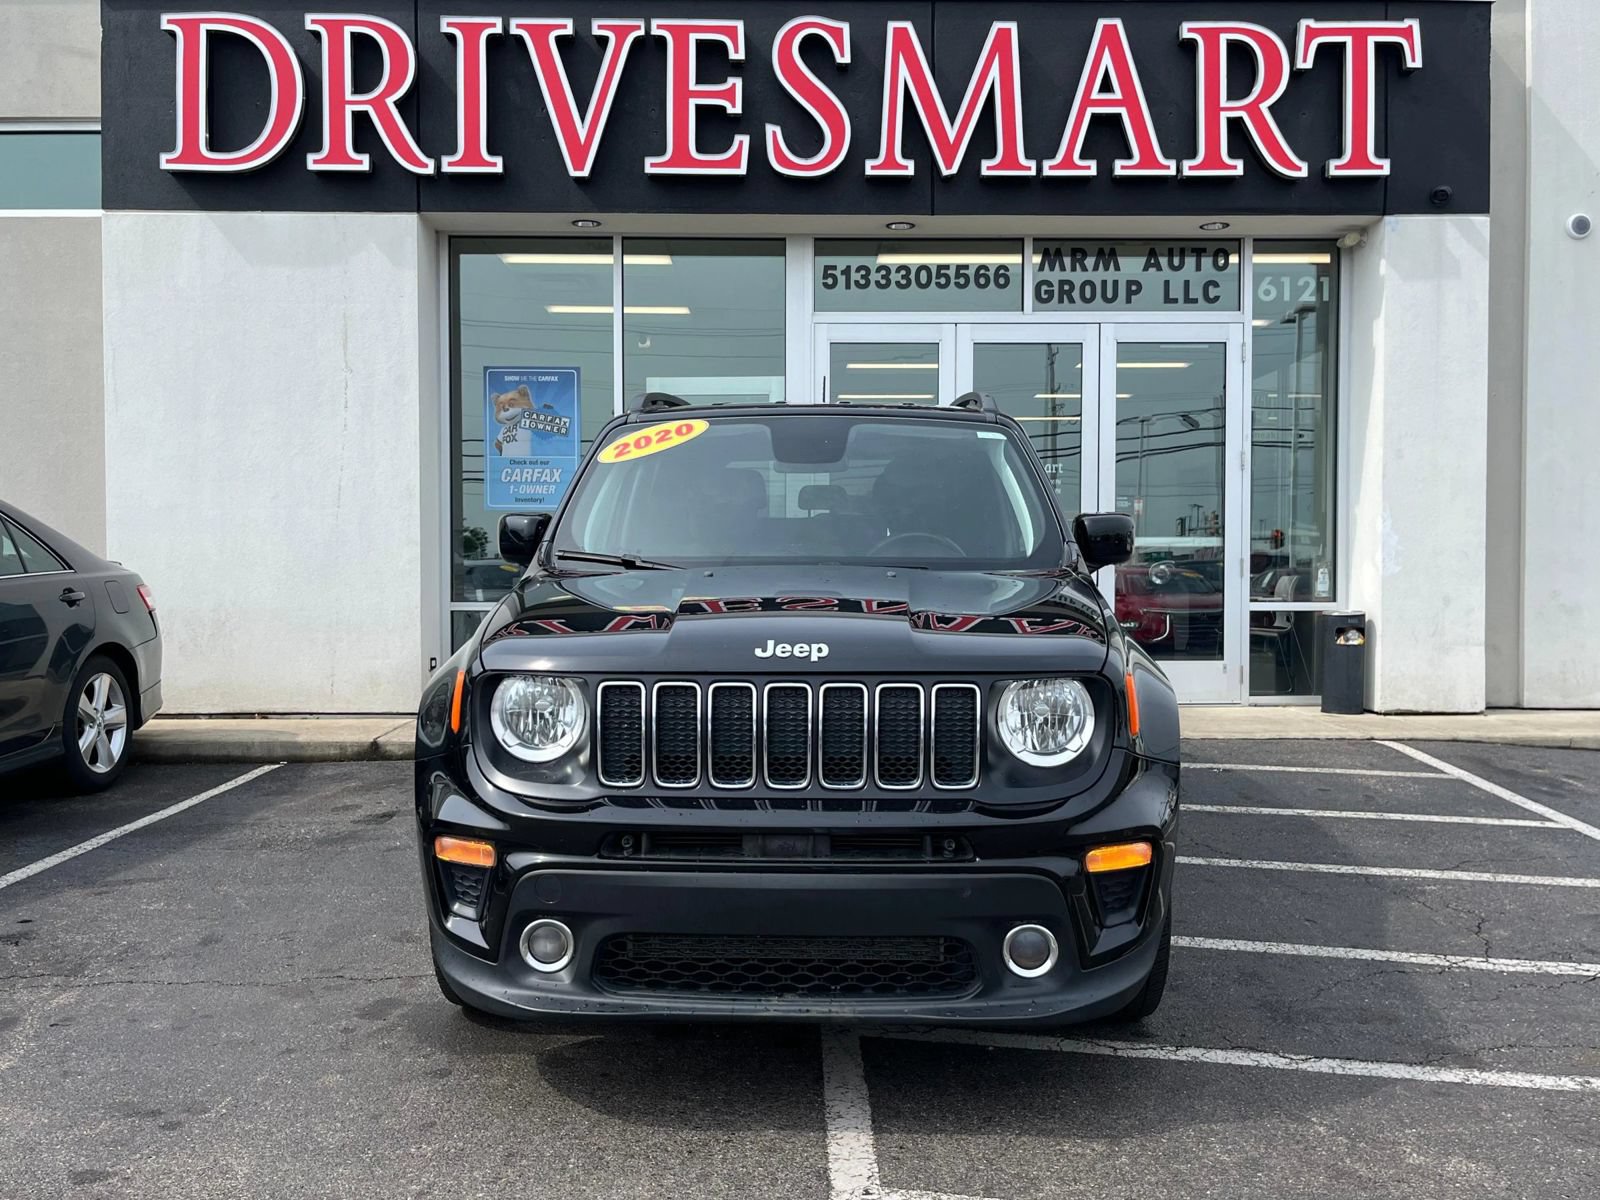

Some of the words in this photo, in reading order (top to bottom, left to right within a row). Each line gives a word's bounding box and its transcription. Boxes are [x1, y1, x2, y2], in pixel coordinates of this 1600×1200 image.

[158, 12, 1423, 178] DRIVESMART
[1037, 247, 1121, 273] MRM
[1142, 247, 1230, 273] AUTO
[822, 264, 1011, 290] 5133305566
[1257, 276, 1330, 302] 6121
[1034, 279, 1143, 305] GROUP
[1163, 279, 1221, 305] LLC
[523, 410, 569, 427] CARFAX
[613, 423, 694, 459] 2020
[501, 468, 562, 483] CARFAX
[509, 485, 556, 494] 1-OWNER
[754, 640, 830, 662] Jeep
